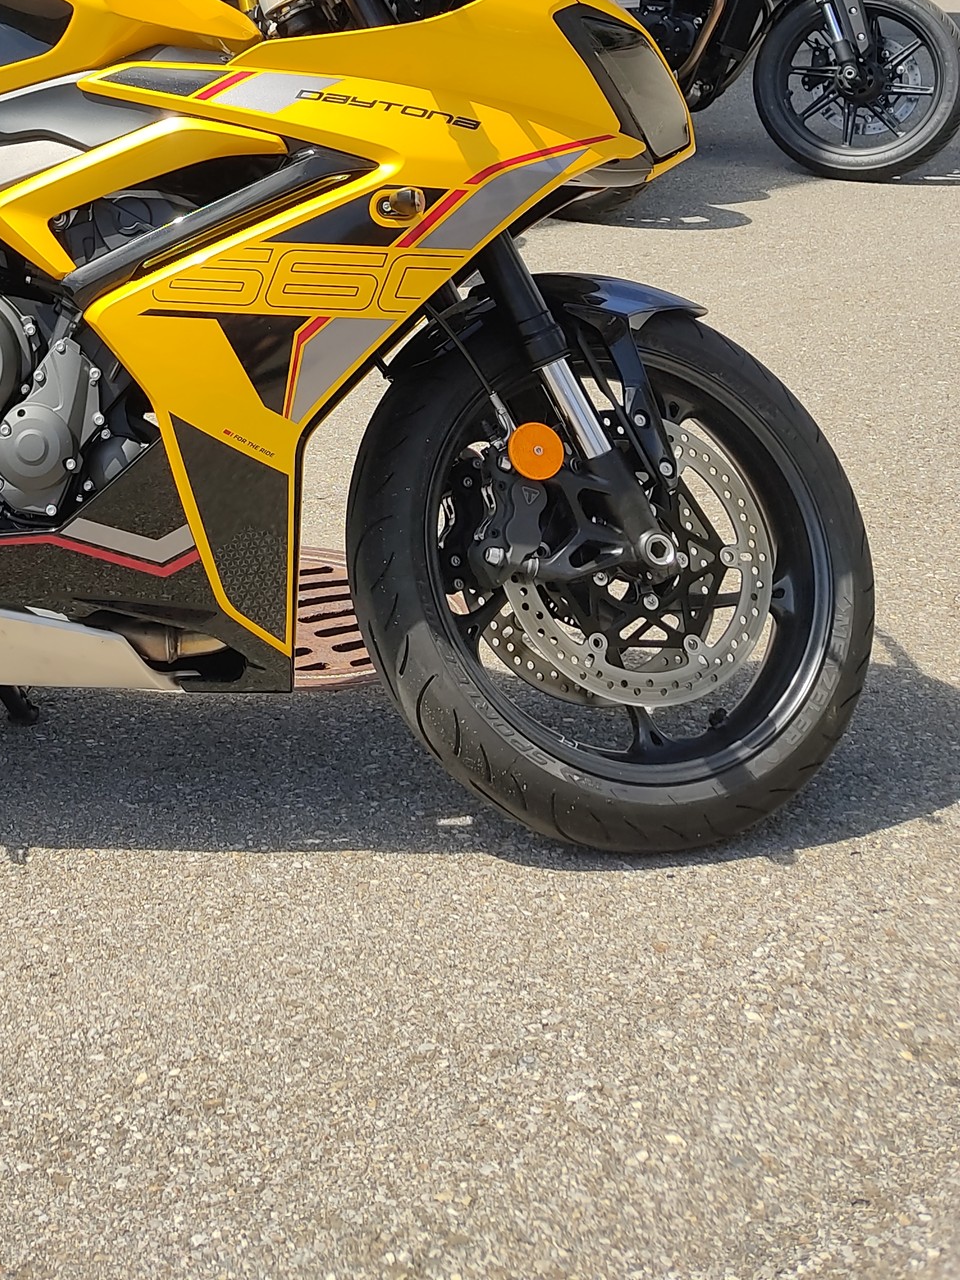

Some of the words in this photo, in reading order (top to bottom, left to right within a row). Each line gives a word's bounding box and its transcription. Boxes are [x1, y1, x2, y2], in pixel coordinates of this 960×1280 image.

[233, 433, 248, 445] FOR
[246, 440, 261, 451] THE
[259, 447, 276, 458] RIDE
